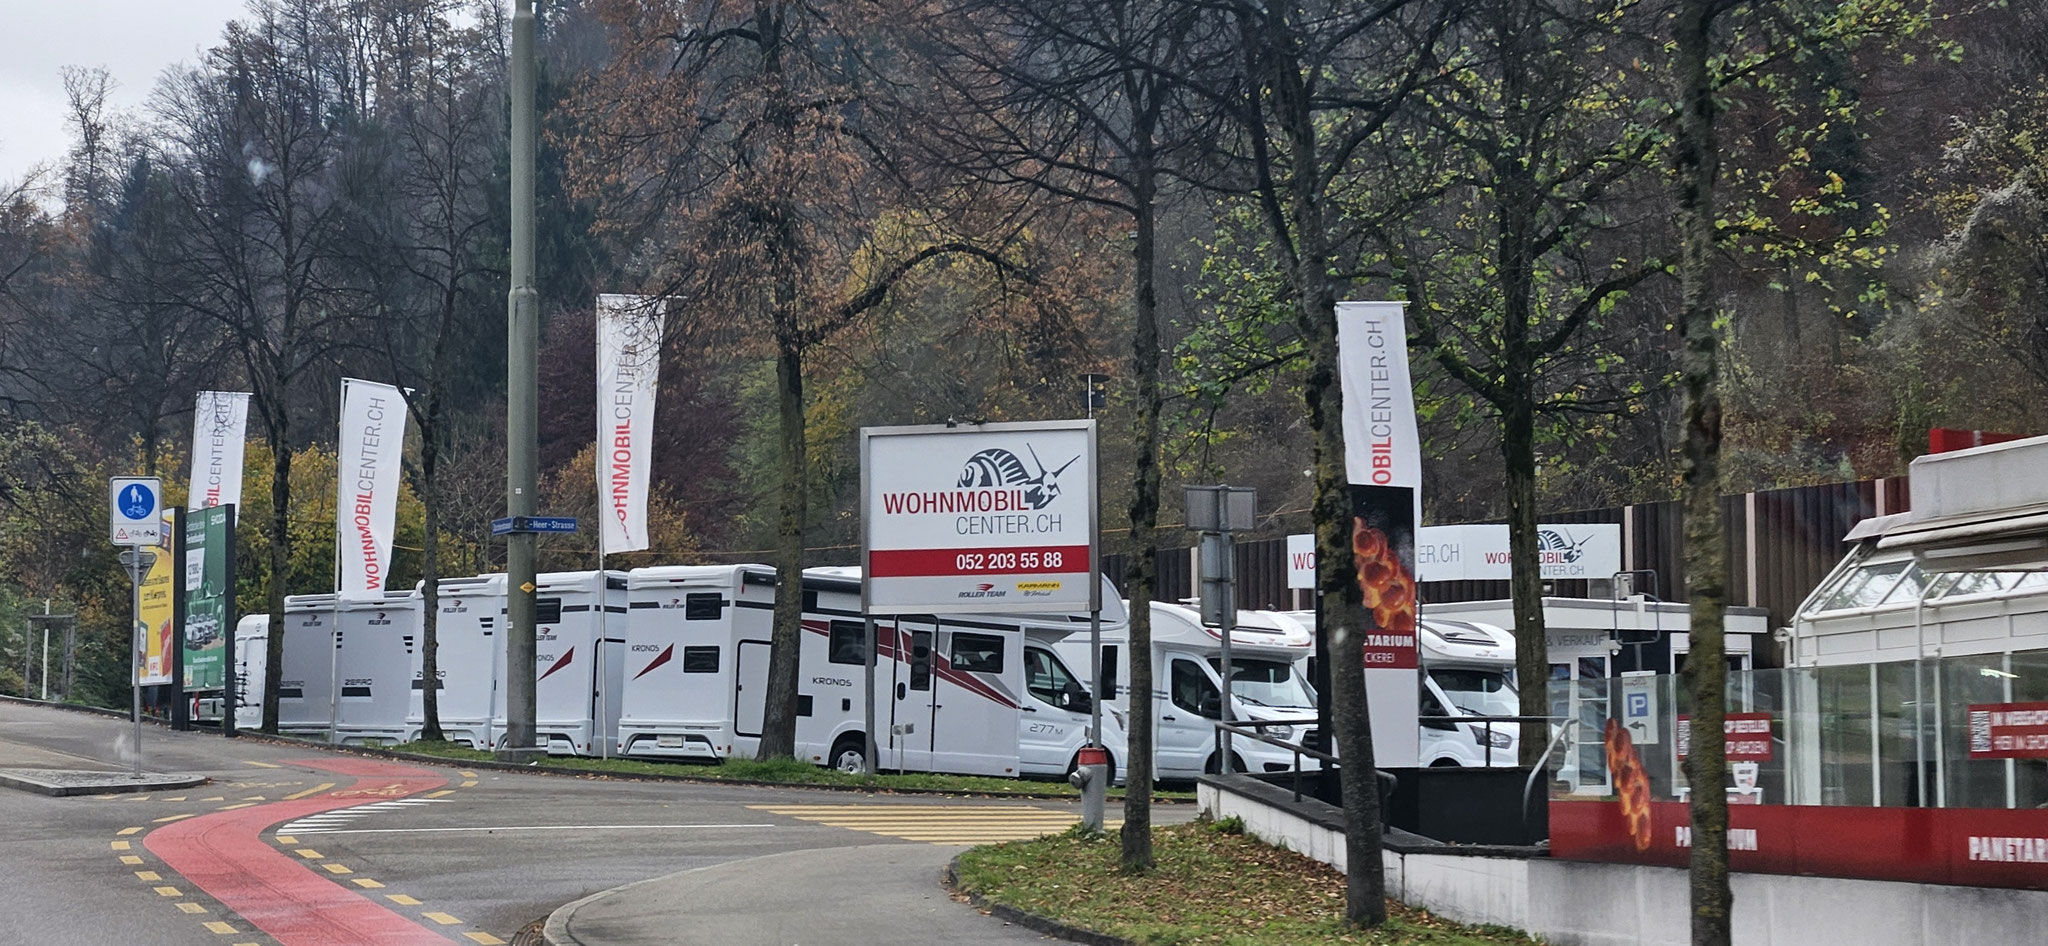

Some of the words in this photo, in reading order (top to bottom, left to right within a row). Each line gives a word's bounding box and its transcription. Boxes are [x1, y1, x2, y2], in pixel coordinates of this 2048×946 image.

[1365, 320, 1392, 486] OBILCENTER.CH
[353, 397, 386, 591] WOHNMOBILCENTER.CH
[883, 489, 1030, 515] WOHNMOBIL
[956, 513, 1062, 535] CENTER.CH
[956, 554, 984, 570] 052
[988, 553, 1016, 569] 203
[1020, 552, 1039, 569] 55
[1043, 551, 1063, 568] 88
[1540, 565, 1585, 575] NTER.CH
[1557, 634, 1605, 647] VERKAUF
[1364, 652, 1395, 663] CKEREI
[812, 676, 852, 687] KRONOS
